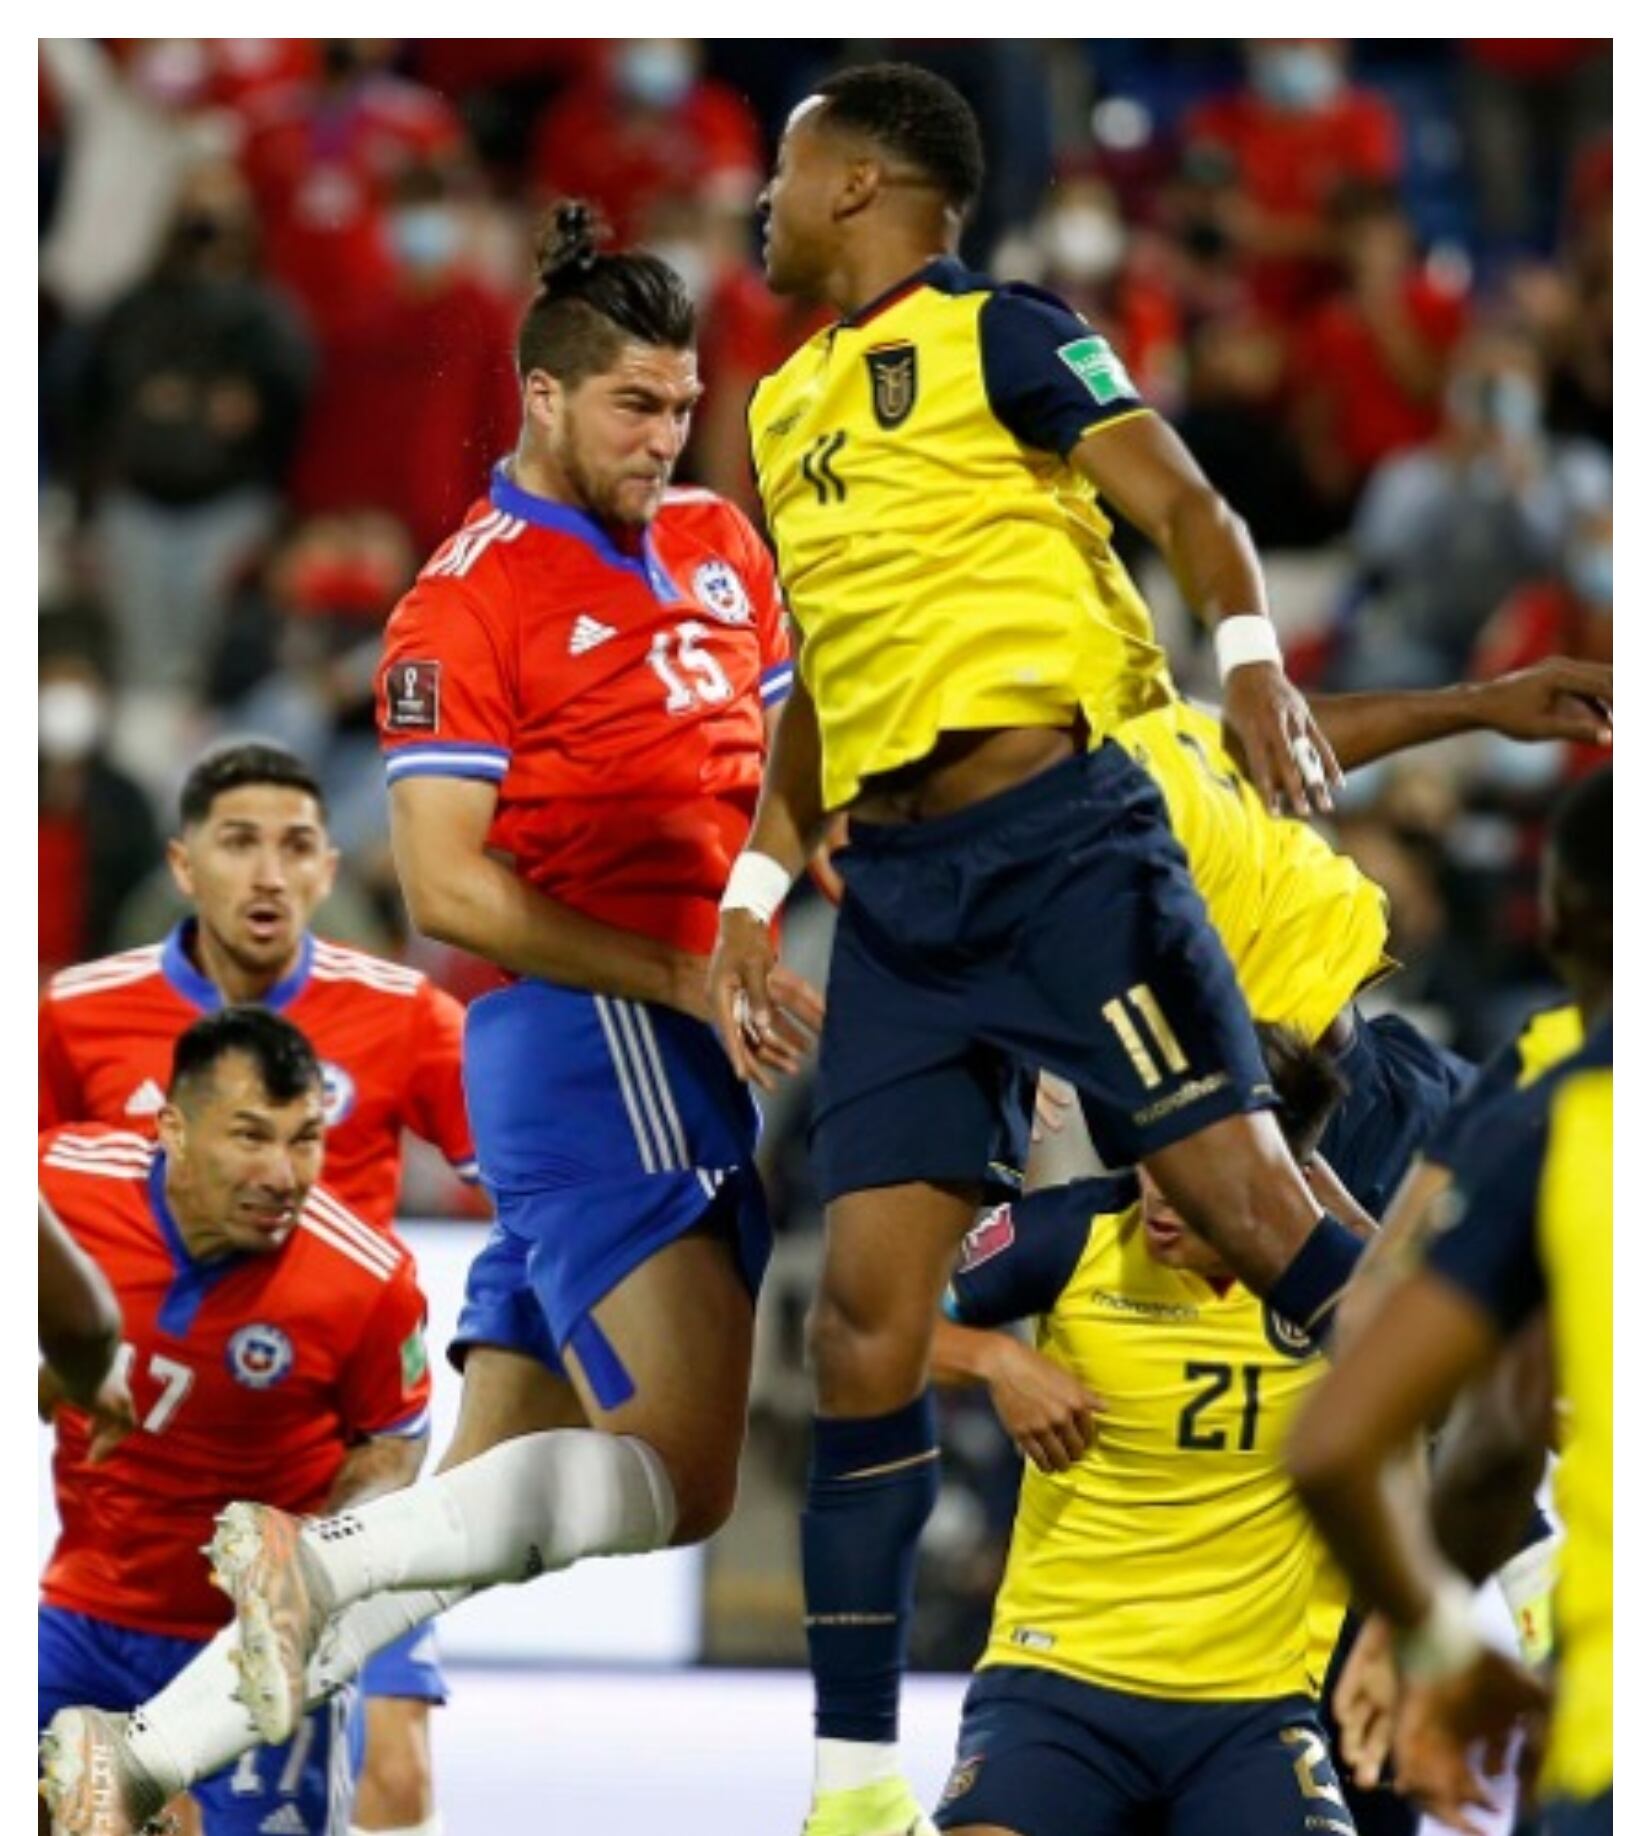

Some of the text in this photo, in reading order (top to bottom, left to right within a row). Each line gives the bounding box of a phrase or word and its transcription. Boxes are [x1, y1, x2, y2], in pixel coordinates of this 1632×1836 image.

[802, 430, 847, 505] 11
[648, 620, 732, 716] 15
[1102, 983, 1189, 1090] 11
[1177, 1362, 1262, 1450] 21
